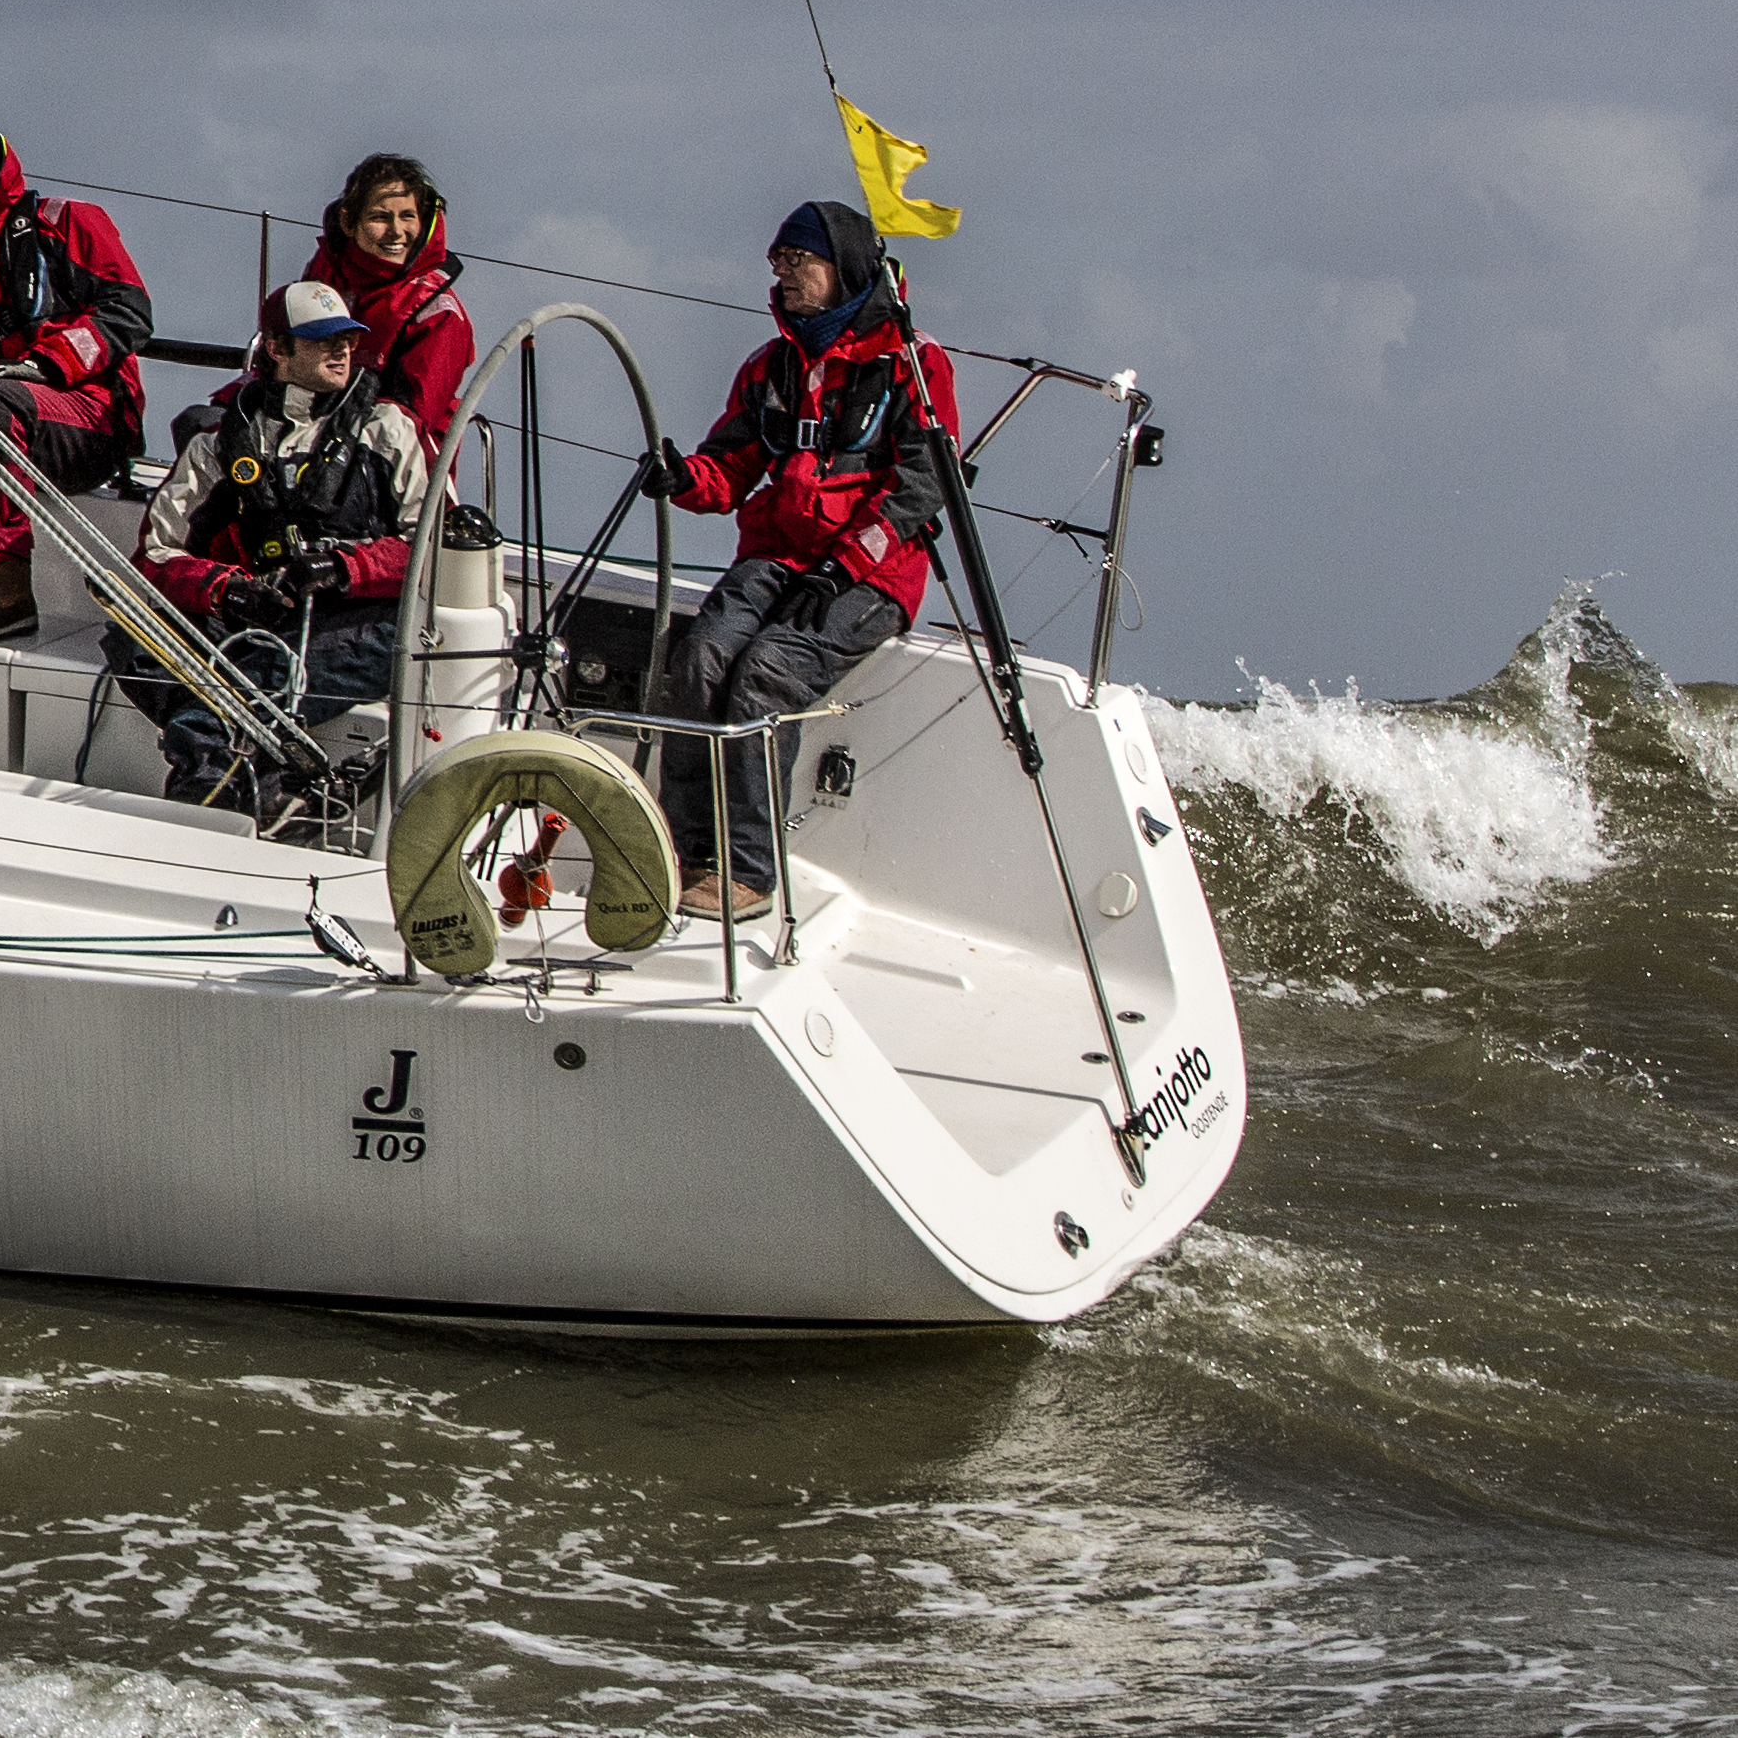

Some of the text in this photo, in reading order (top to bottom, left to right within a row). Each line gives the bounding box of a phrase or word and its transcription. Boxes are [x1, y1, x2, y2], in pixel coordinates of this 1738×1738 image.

[411, 914, 459, 935] LALIZAS
[1127, 1046, 1211, 1151] anjotto
[1190, 1089, 1229, 1140] OOSTENDE
[351, 1132, 427, 1163] 109
